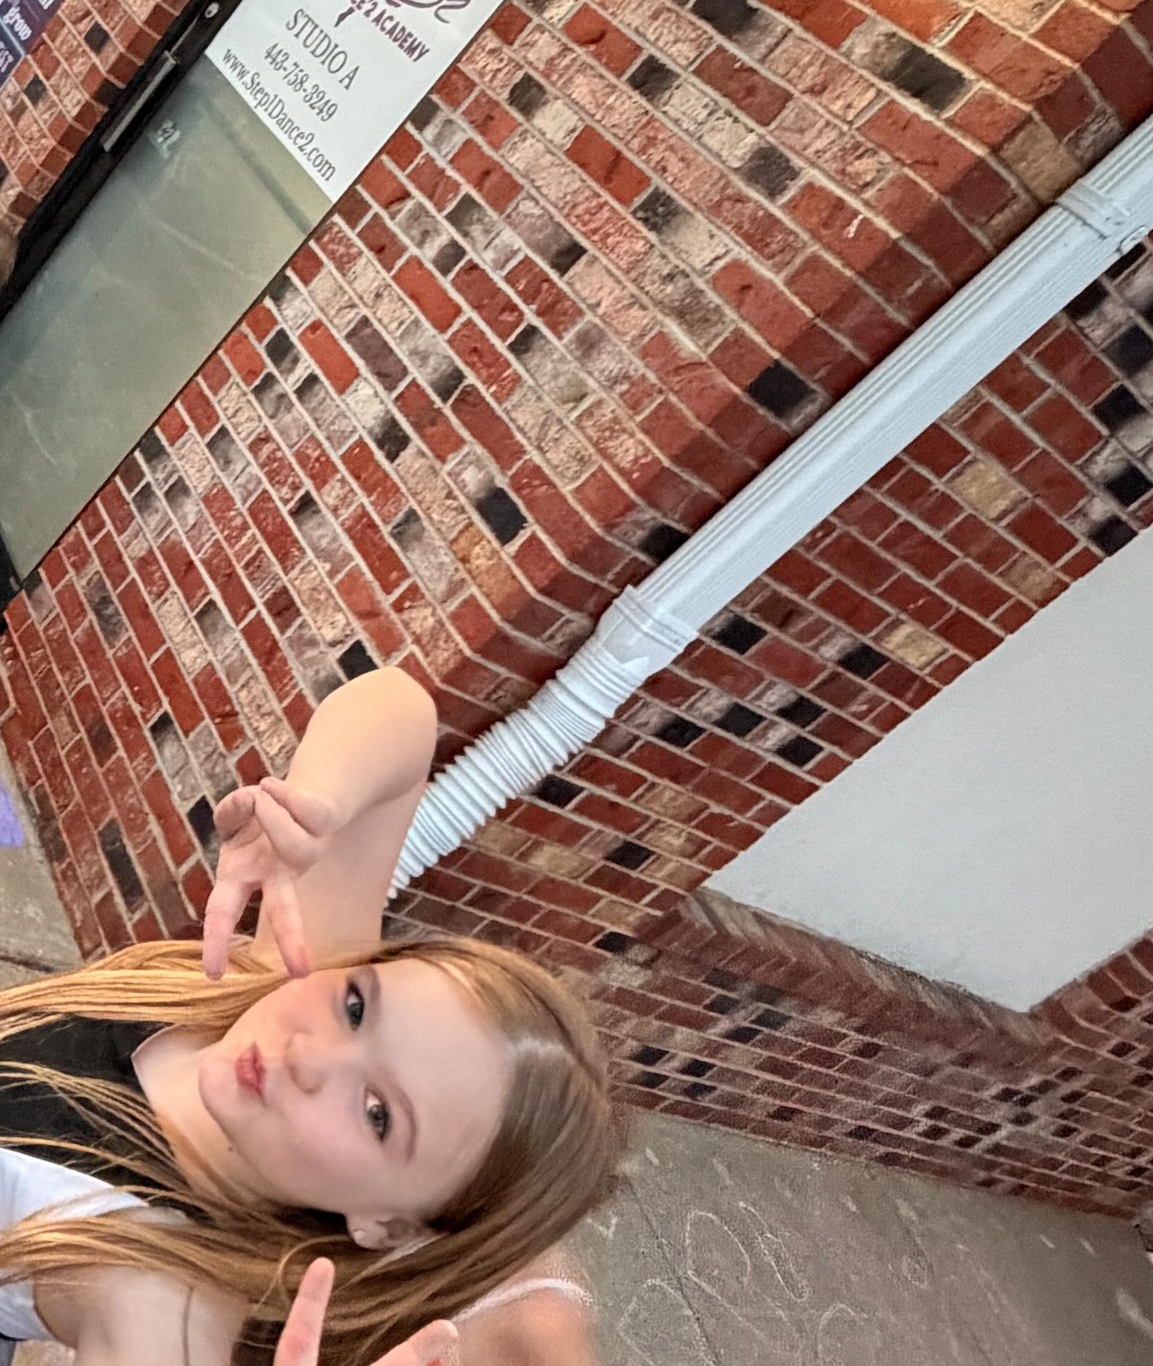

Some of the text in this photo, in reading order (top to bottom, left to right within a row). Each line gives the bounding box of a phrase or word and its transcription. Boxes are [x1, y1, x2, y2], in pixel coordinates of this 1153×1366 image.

[3, 7, 32, 41] grow
[286, 8, 361, 91] STUDIO A
[371, 8, 430, 63] ACADEMY
[222, 48, 337, 183] www.Step1Dance2.com
[263, 42, 339, 122] 443-758-3249
